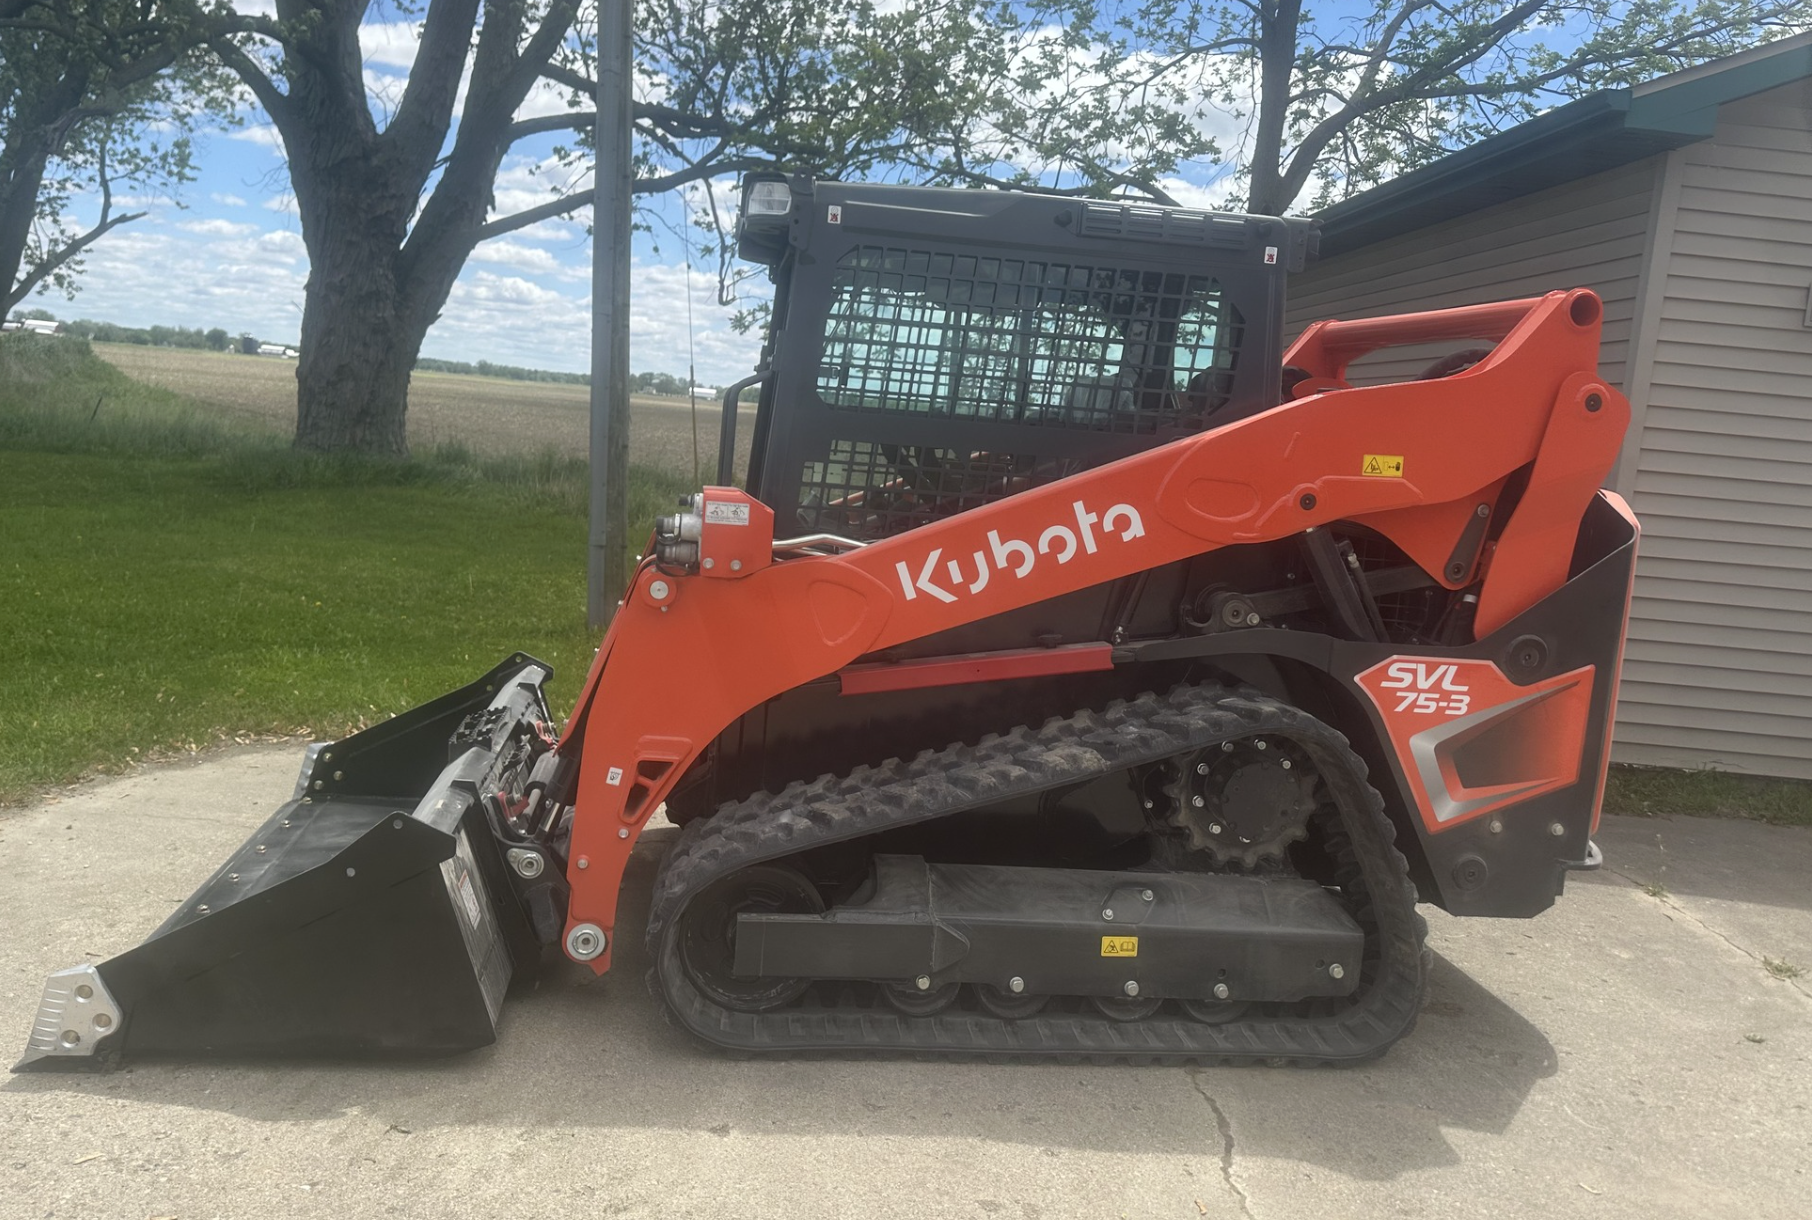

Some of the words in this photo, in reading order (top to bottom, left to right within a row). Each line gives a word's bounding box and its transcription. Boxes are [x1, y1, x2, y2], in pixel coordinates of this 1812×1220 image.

[896, 500, 1145, 604] Kubota
[1380, 662, 1469, 692] SVL
[1394, 692, 1471, 716] 75-3
